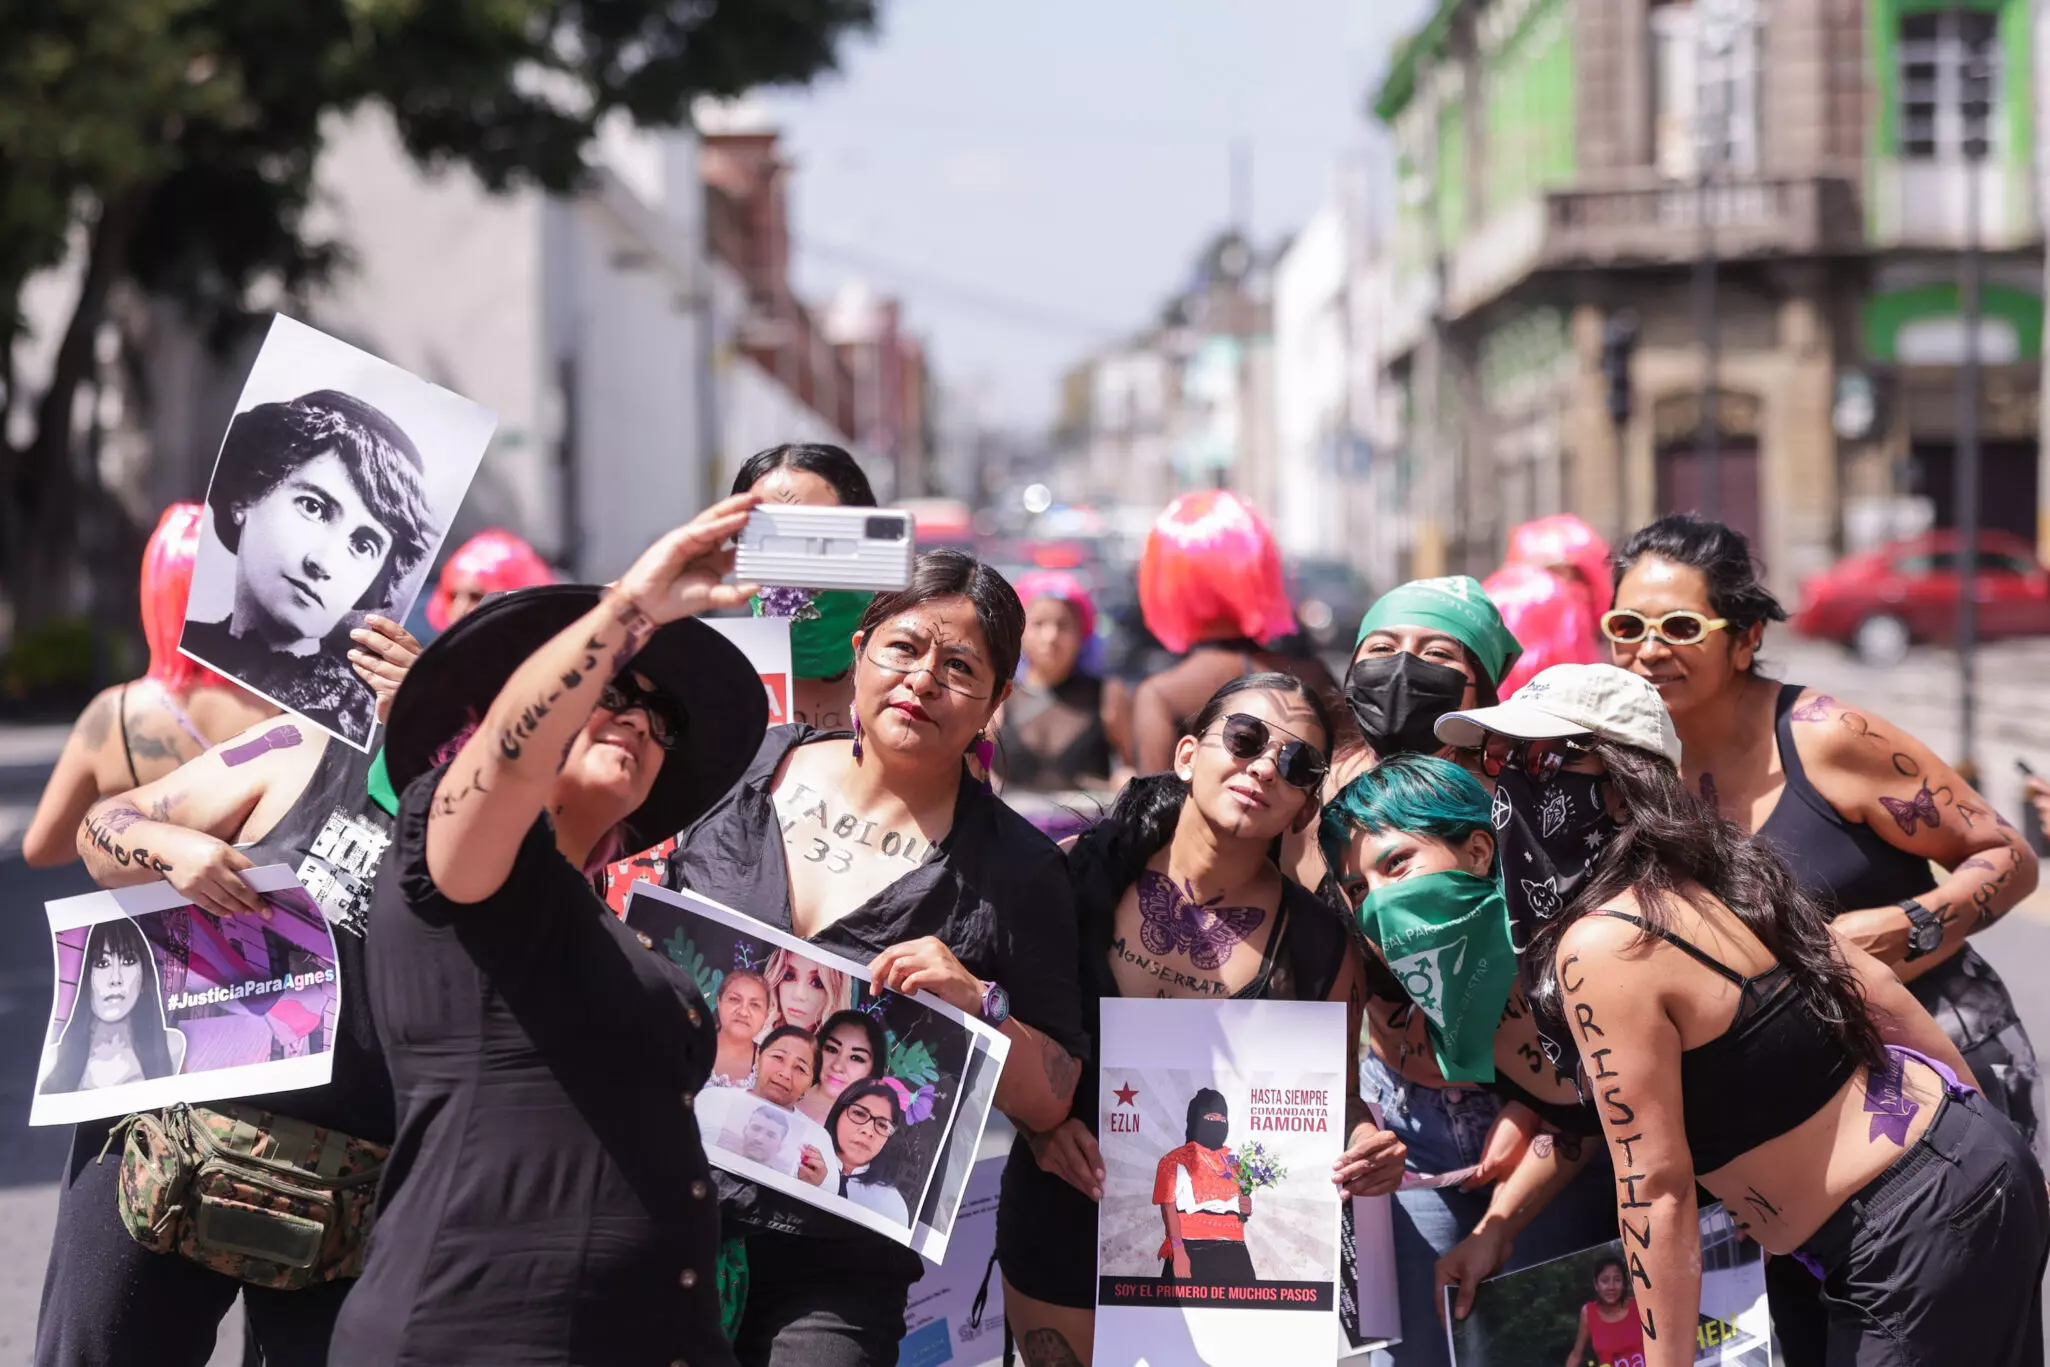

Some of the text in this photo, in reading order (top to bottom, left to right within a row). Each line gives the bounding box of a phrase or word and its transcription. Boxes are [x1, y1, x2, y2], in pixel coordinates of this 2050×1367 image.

[167, 968, 336, 1011] #JusticiaParaAgnes
[1250, 1088, 1328, 1106] HASTA SIEMPRE
[1250, 1107, 1328, 1117] COMANDANTA
[1111, 1113, 1140, 1133] EZLN
[1250, 1116, 1328, 1133] RAMONA
[1114, 1284, 1318, 1301] SOY EL PRIMERO DE MUCHOS PASOS
